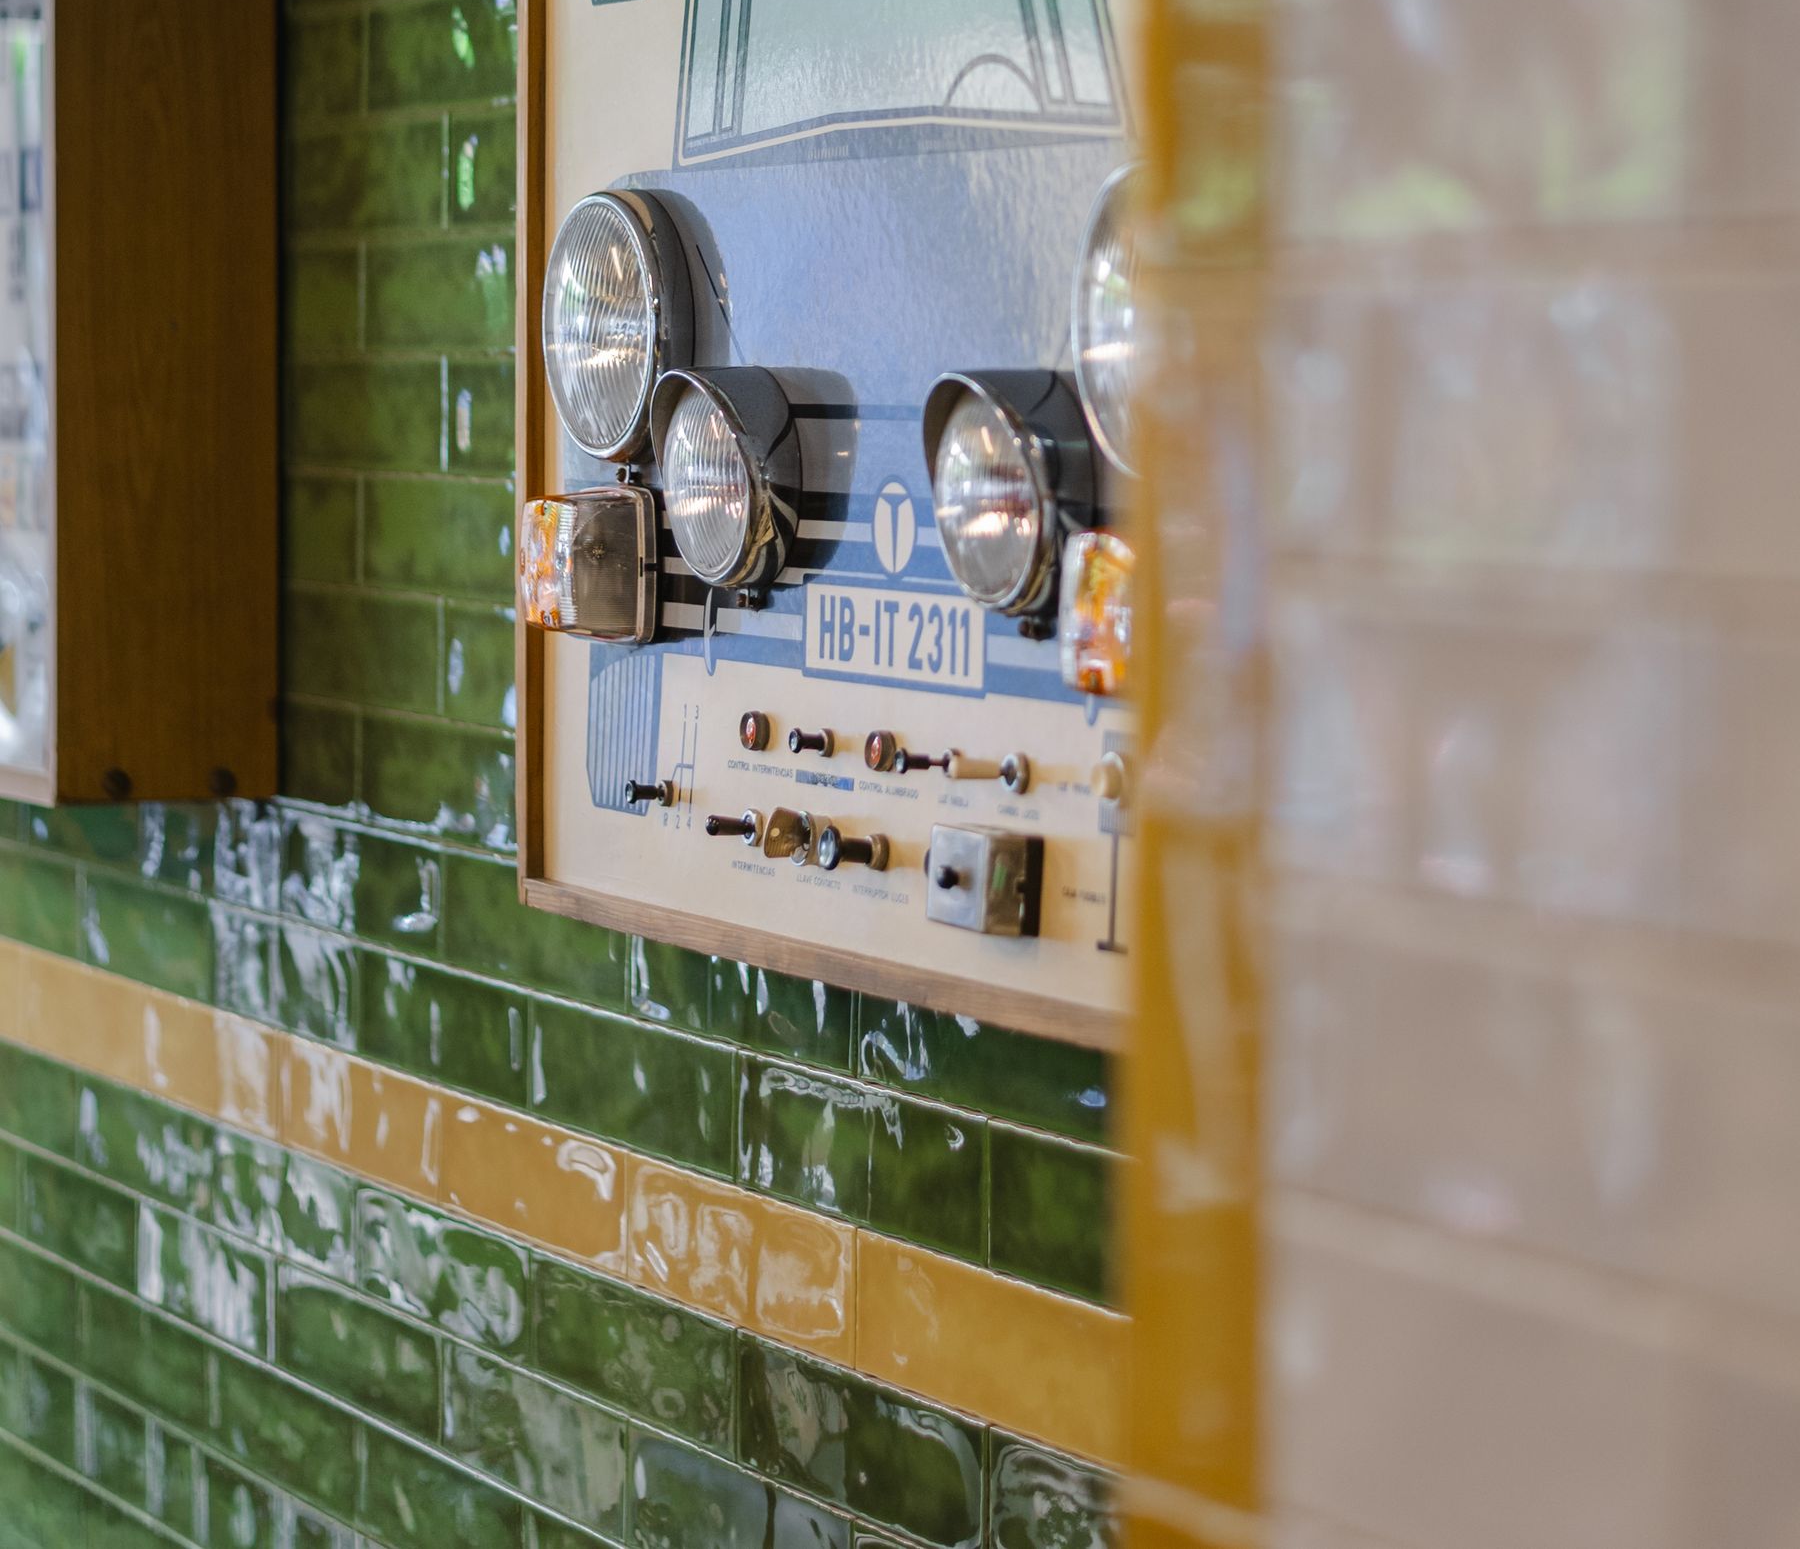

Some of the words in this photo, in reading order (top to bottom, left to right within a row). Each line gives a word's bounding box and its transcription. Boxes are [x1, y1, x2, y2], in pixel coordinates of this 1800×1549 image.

[819, 594, 900, 667] HB-IT
[907, 601, 971, 677] 2311
[694, 704, 700, 720] 3
[727, 759, 750, 772] CONTROL
[675, 814, 681, 830] 2
[686, 816, 692, 830] 4
